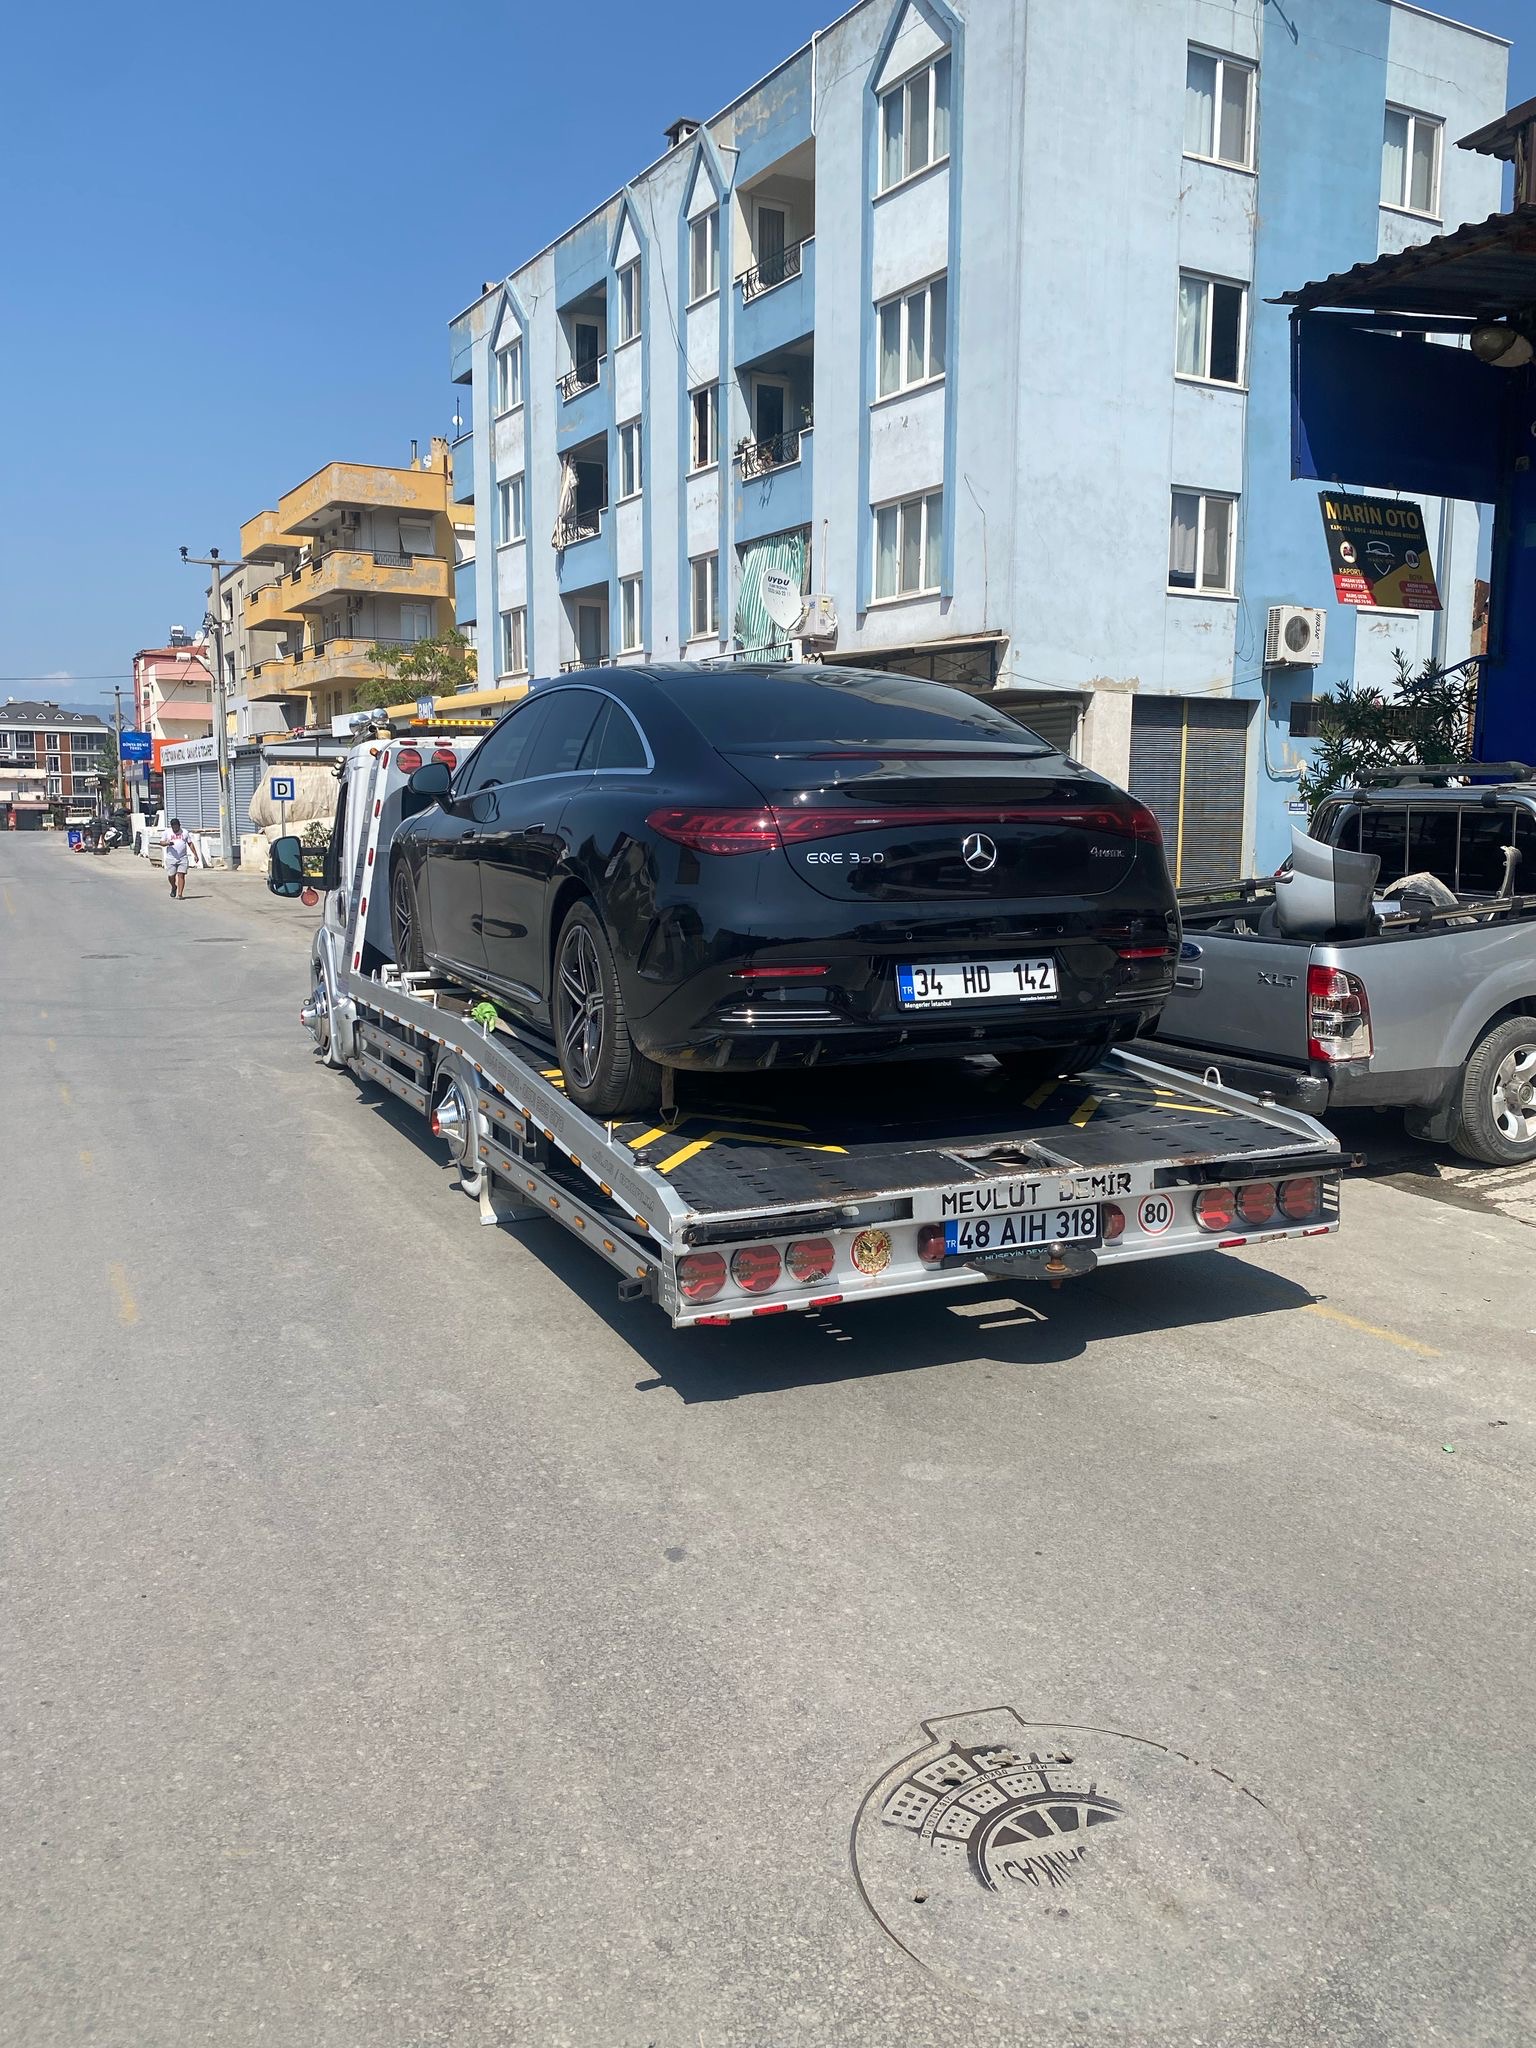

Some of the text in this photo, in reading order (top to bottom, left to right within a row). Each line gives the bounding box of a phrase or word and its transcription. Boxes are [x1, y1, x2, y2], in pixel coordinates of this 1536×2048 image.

[1325, 501, 1419, 529] MARİN OTO
[768, 576, 790, 586] UYDU
[277, 782, 288, 795] D
[806, 852, 885, 864] EQE 350
[914, 962, 1051, 997] 34 HD 142
[1257, 971, 1299, 988] XLT
[902, 986, 913, 995] TR
[942, 1172, 1132, 1215] MEVLÜT DEMİR
[1144, 1203, 1168, 1224] 80
[959, 1207, 1095, 1250] 48 AIH 318
[946, 1239, 957, 1248] TR
